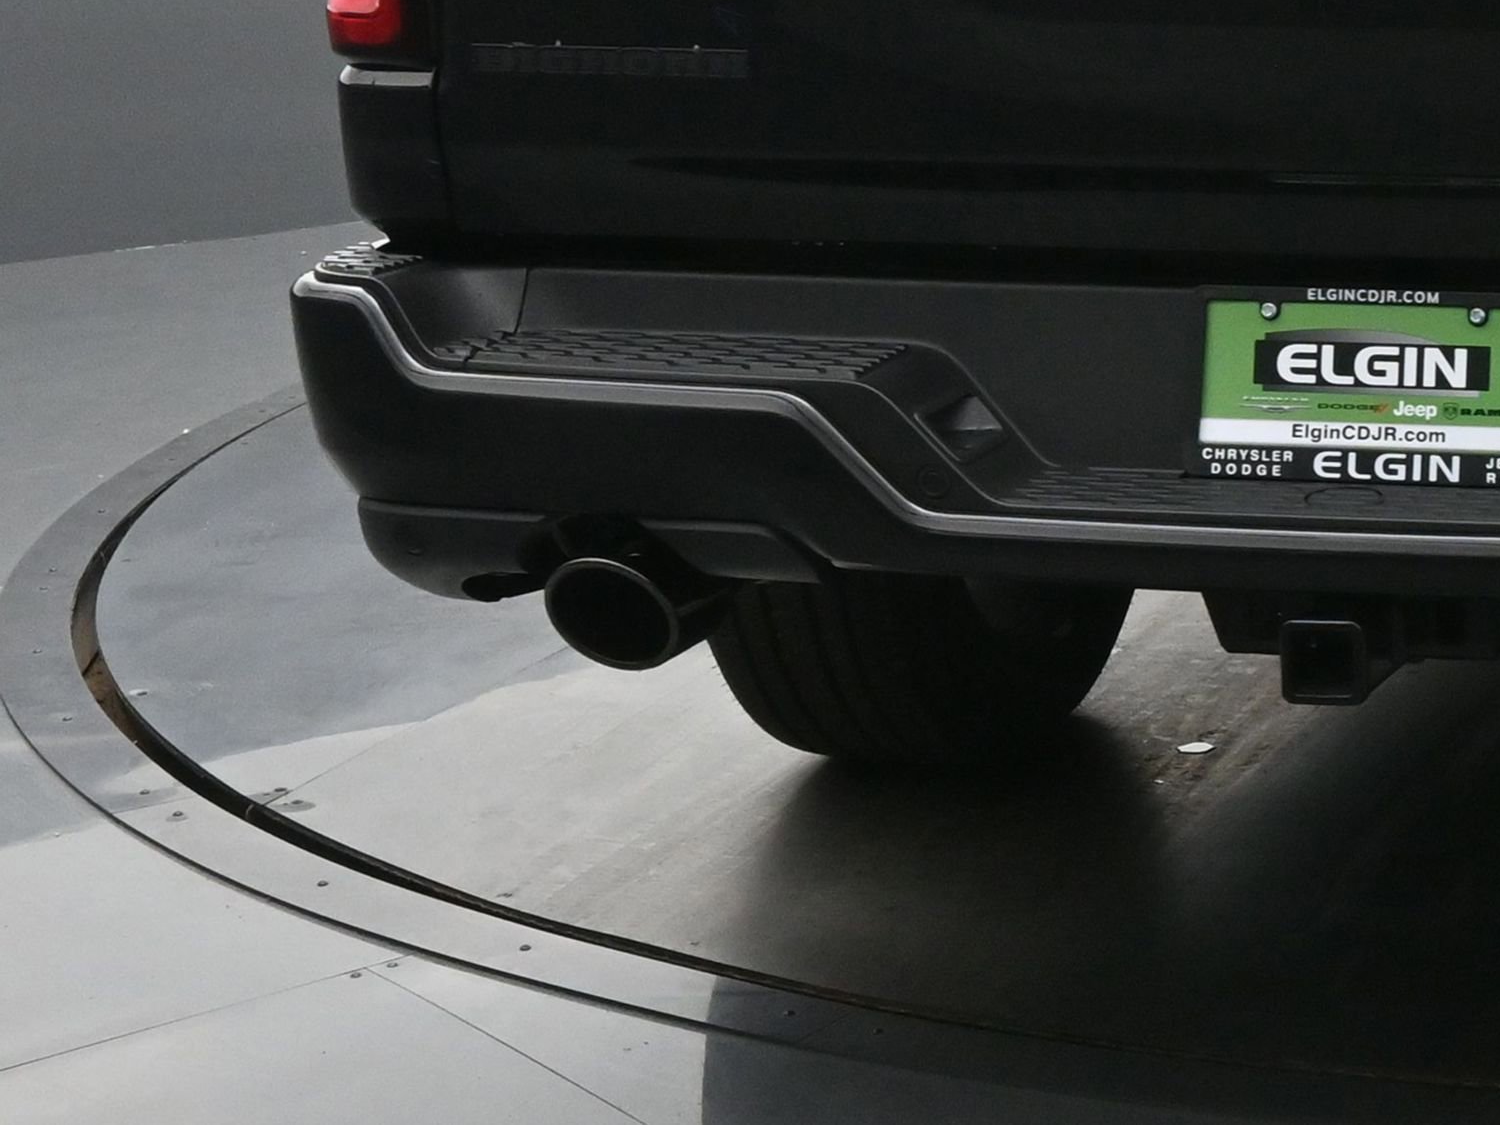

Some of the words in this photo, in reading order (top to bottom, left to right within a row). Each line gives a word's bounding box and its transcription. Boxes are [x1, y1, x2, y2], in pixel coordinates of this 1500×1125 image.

[1307, 288, 1440, 304] ELGINCDJR.COM
[1276, 343, 1468, 388] ELGIN
[1393, 401, 1437, 420] Jeep
[1292, 424, 1446, 443] ElginCDJR.com
[1202, 448, 1293, 462] CHRYSLER
[1211, 463, 1281, 476] DODGE
[1313, 451, 1460, 483] ELGIN
